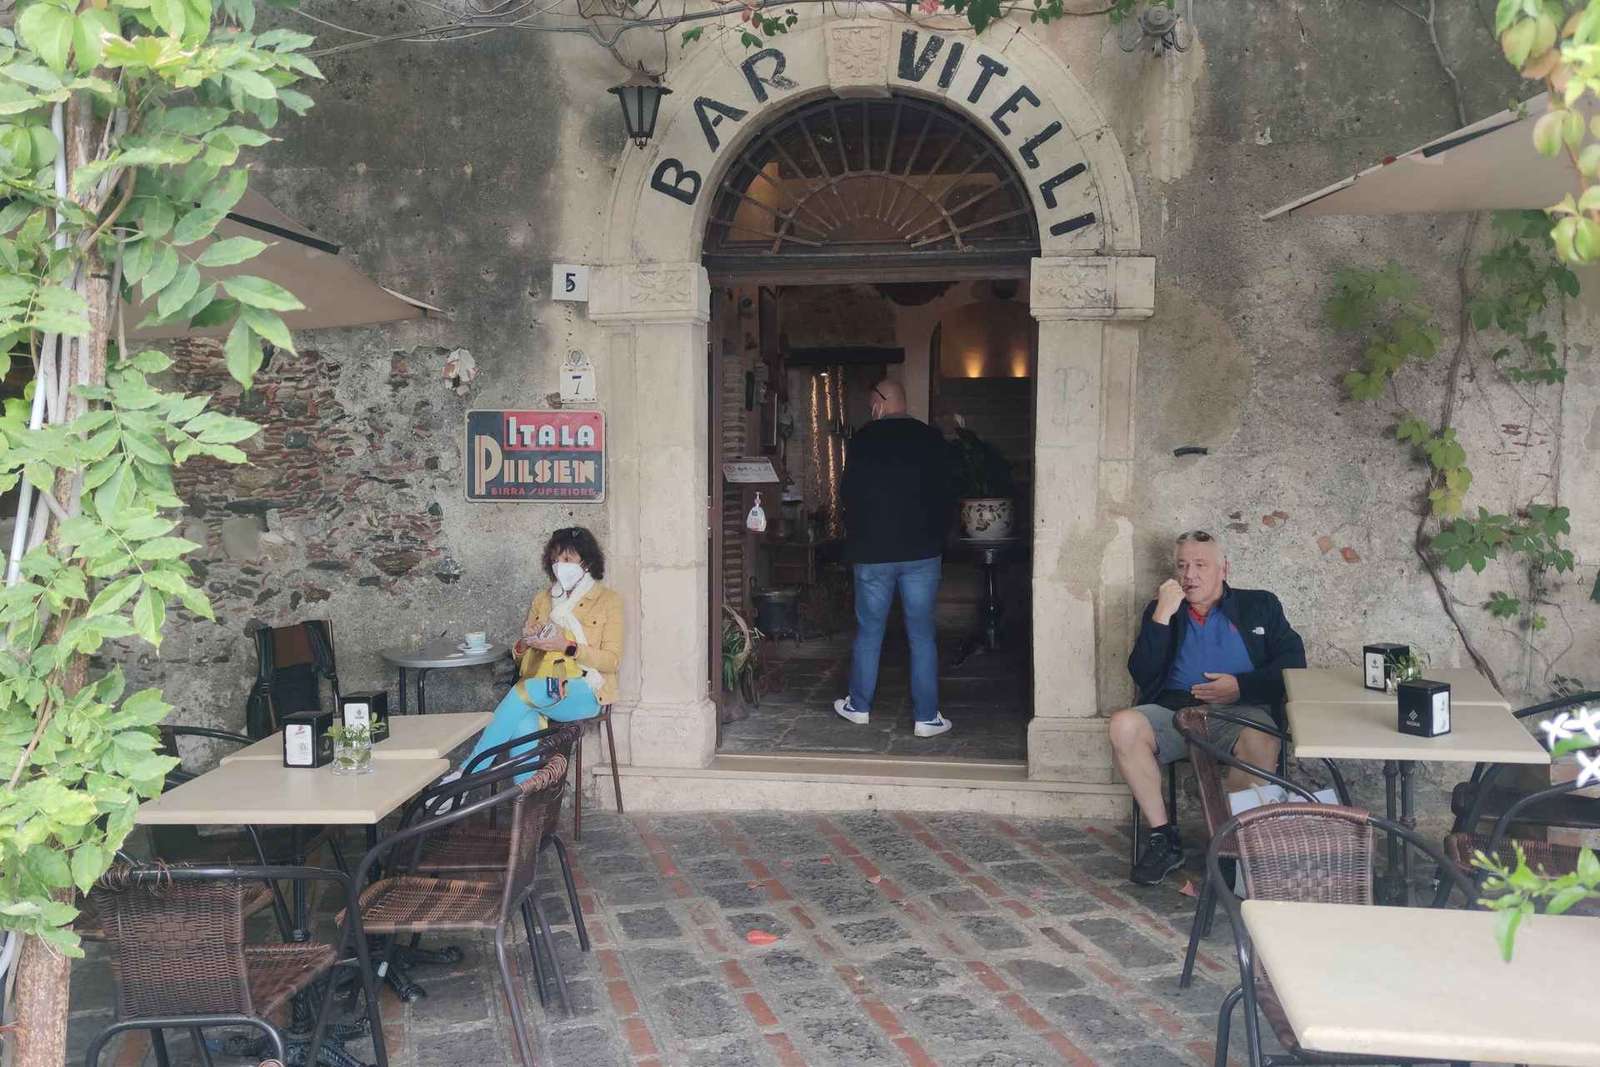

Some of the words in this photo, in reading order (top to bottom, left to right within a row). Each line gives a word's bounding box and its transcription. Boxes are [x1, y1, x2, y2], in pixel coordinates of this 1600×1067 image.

[651, 48, 799, 205] BAR
[898, 30, 1096, 236] VITELLI
[565, 272, 577, 293] 5
[509, 416, 595, 446] ITALA
[475, 435, 595, 495] PILSEN
[491, 488, 525, 496] BIRRA
